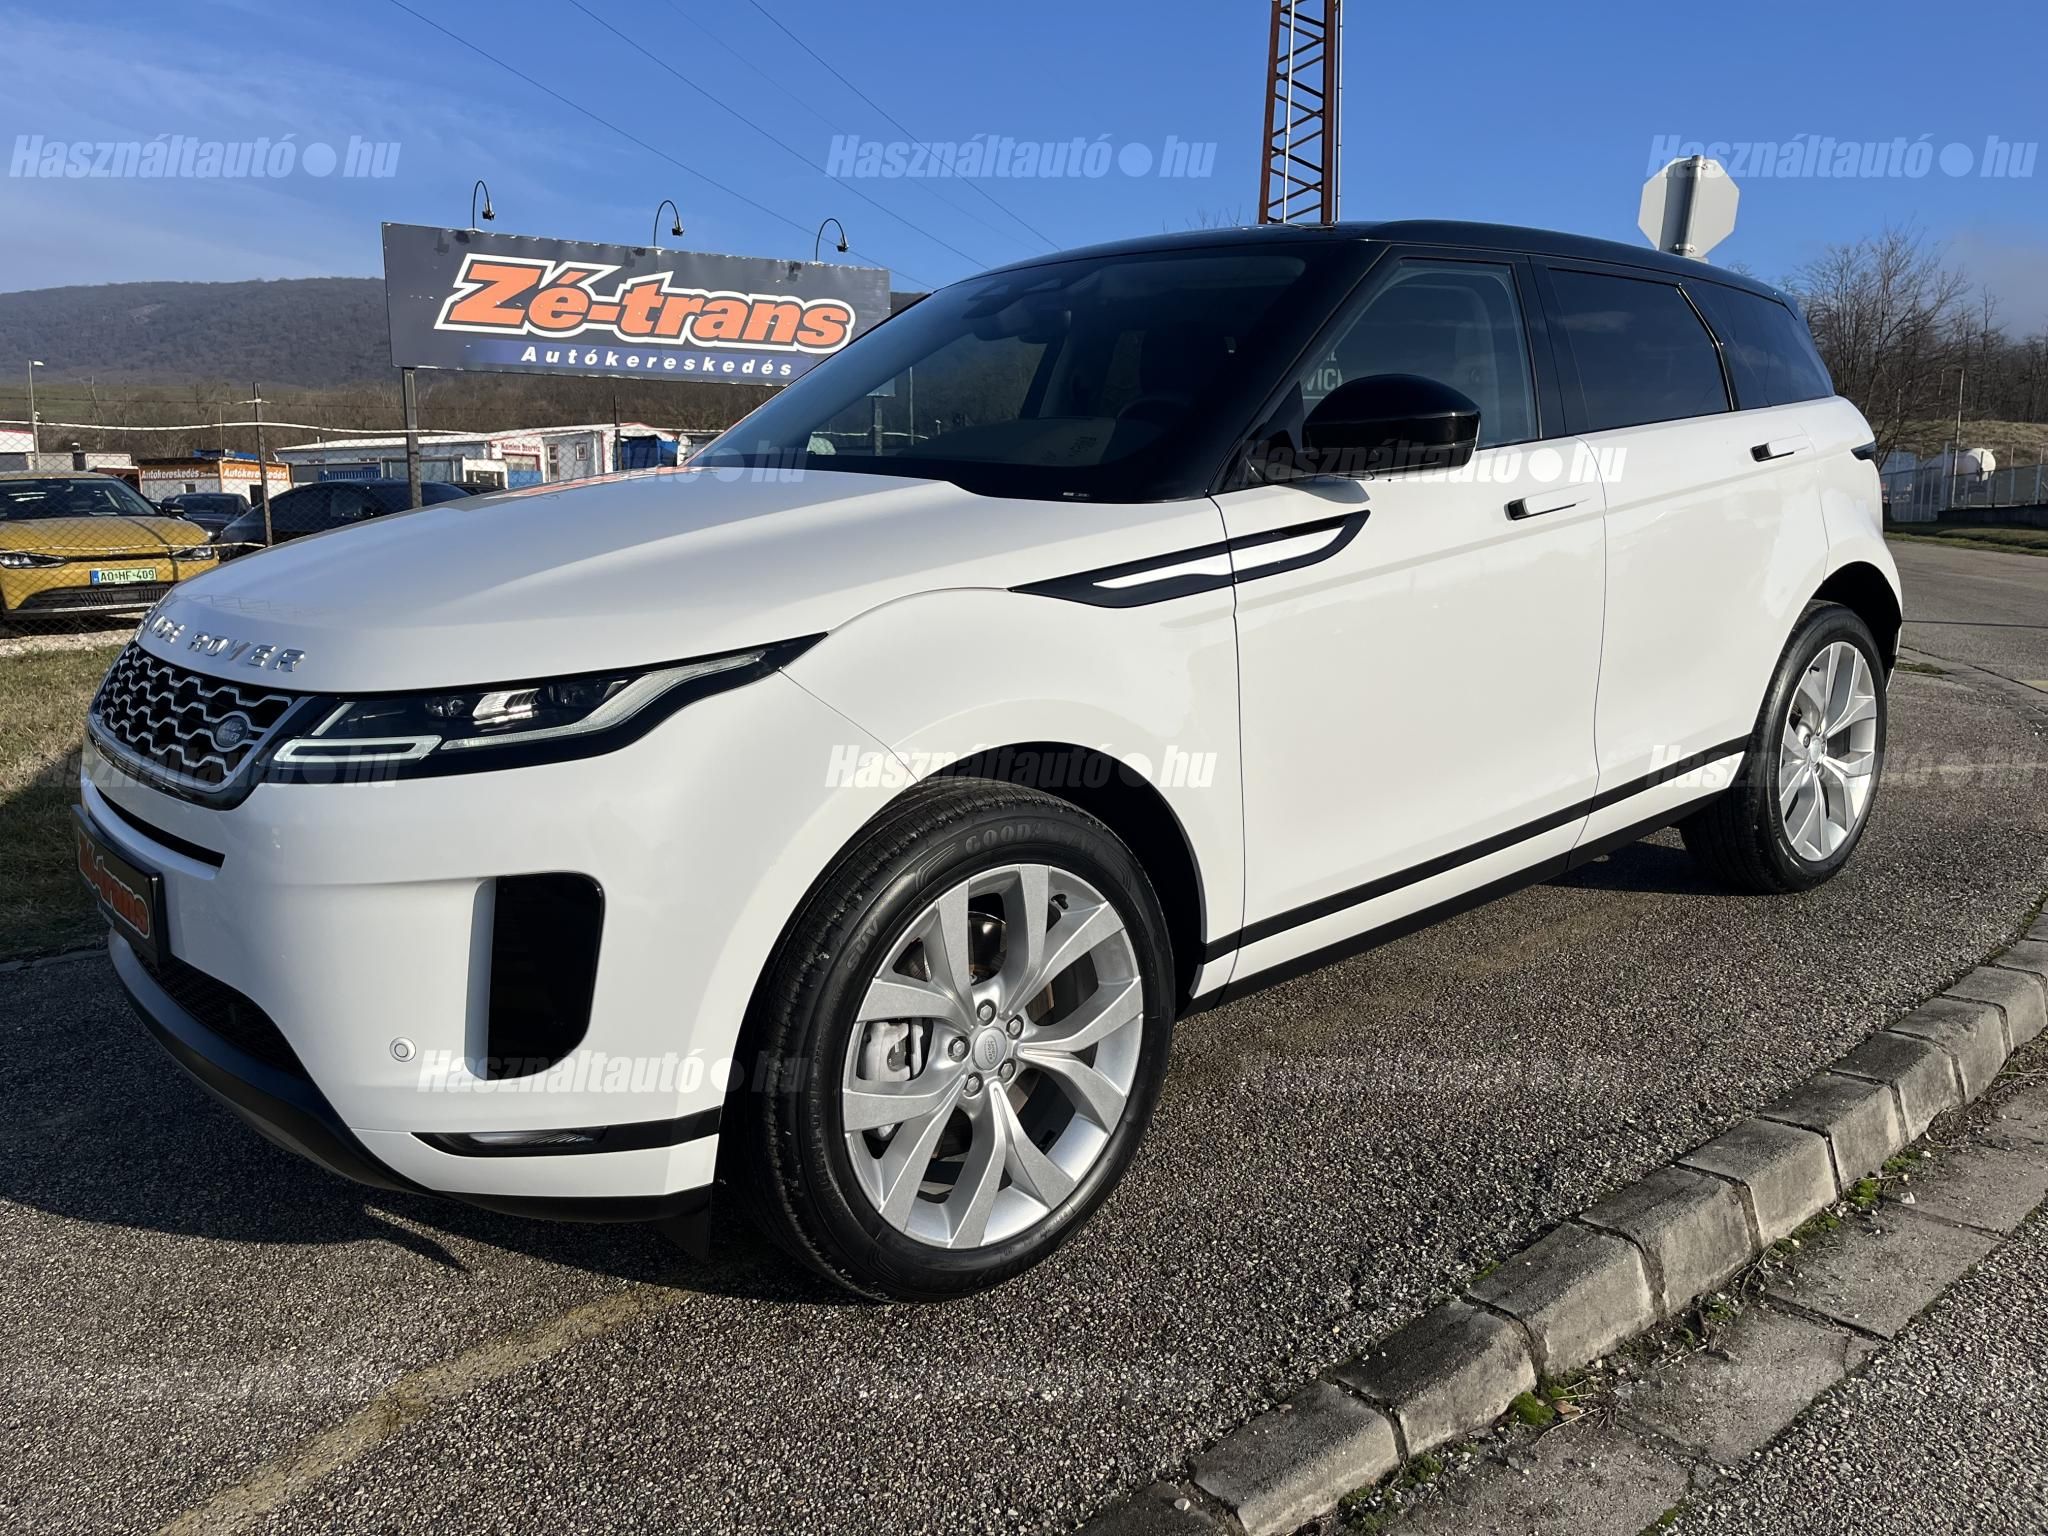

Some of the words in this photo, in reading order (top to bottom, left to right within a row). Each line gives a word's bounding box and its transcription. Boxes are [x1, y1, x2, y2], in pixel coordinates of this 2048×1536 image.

[443, 260, 853, 350] Zé-trans
[521, 345, 793, 377] Autókereskedés
[223, 468, 288, 480] Autókerekedés
[187, 631, 306, 672] ROVER
